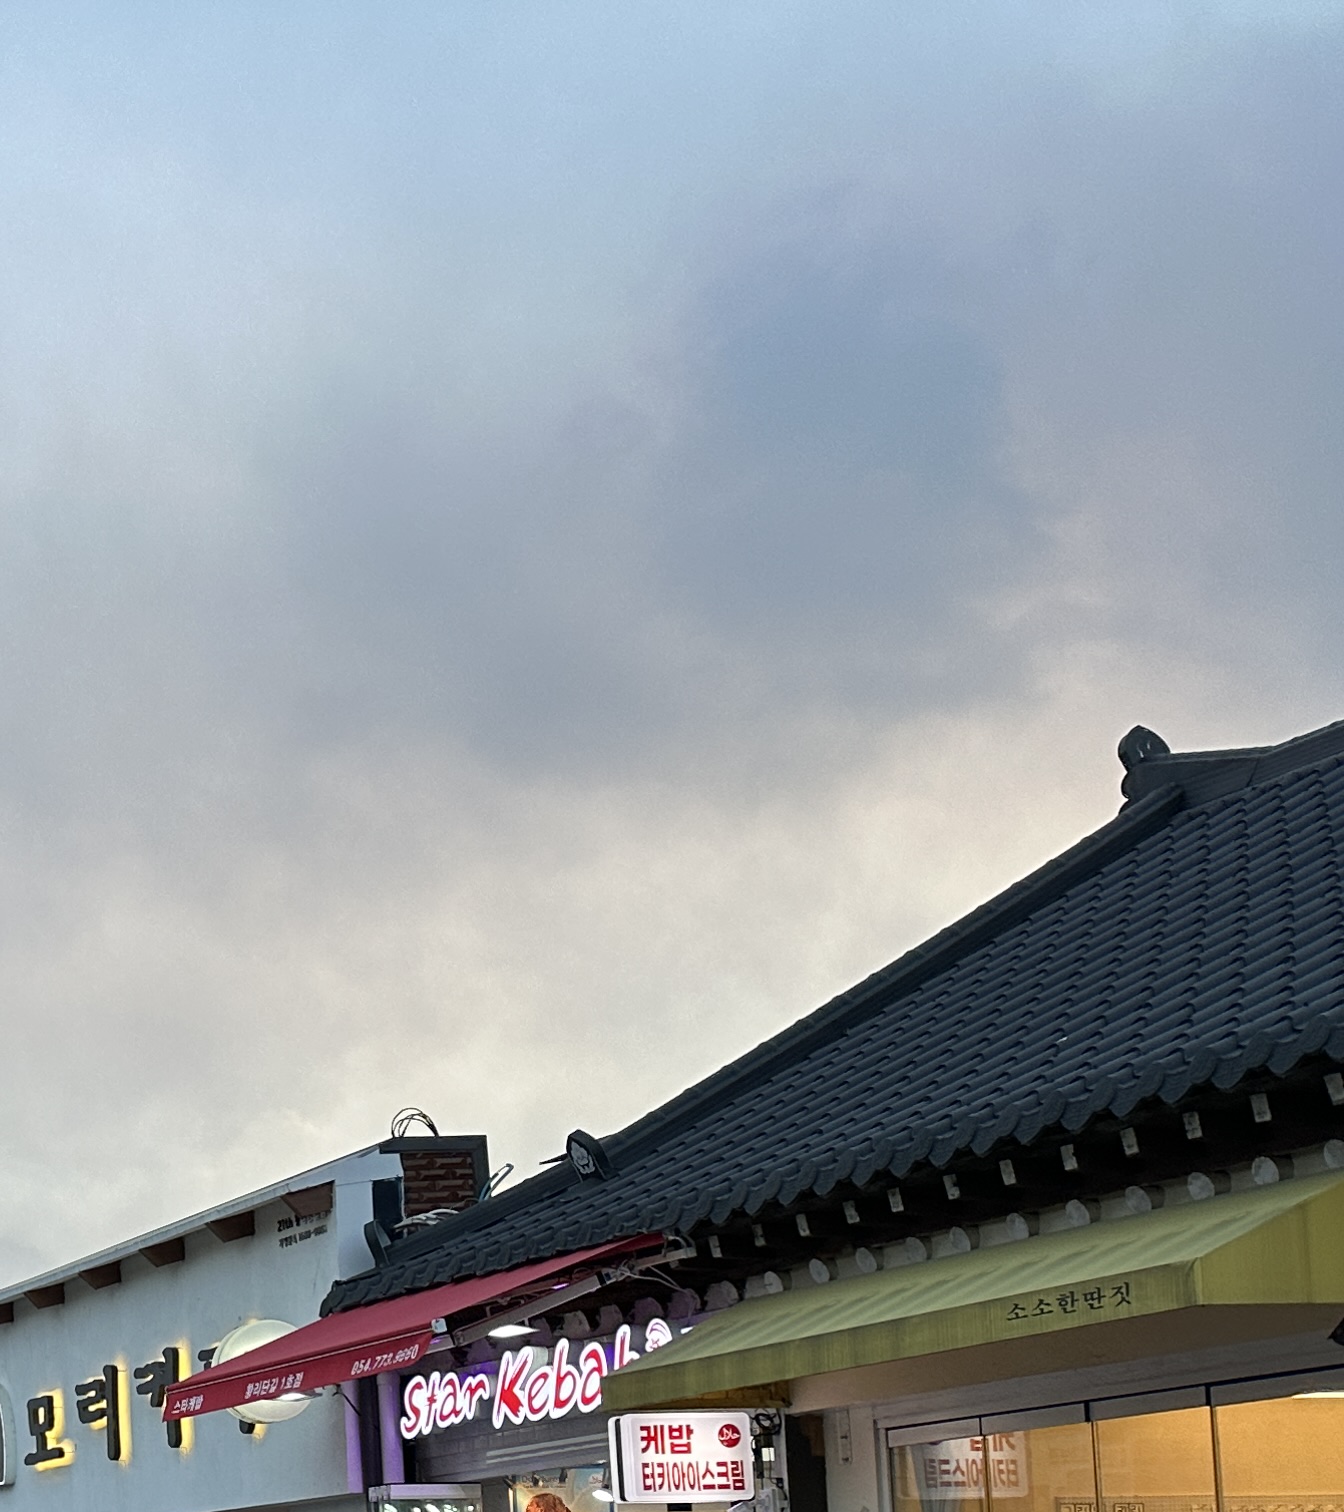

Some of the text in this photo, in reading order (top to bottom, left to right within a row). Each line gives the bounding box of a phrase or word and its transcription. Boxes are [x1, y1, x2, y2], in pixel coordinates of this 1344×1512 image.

[1006, 1281, 1132, 1321] 소소한딴짓
[171, 1372, 304, 1414] 스타케밥 황리단길 1호점
[401, 1324, 640, 1439] Star Kebab
[24, 1345, 255, 1466] 모리커
[640, 1424, 694, 1455] 케밥
[642, 1460, 745, 1492] 터키아이스크림
